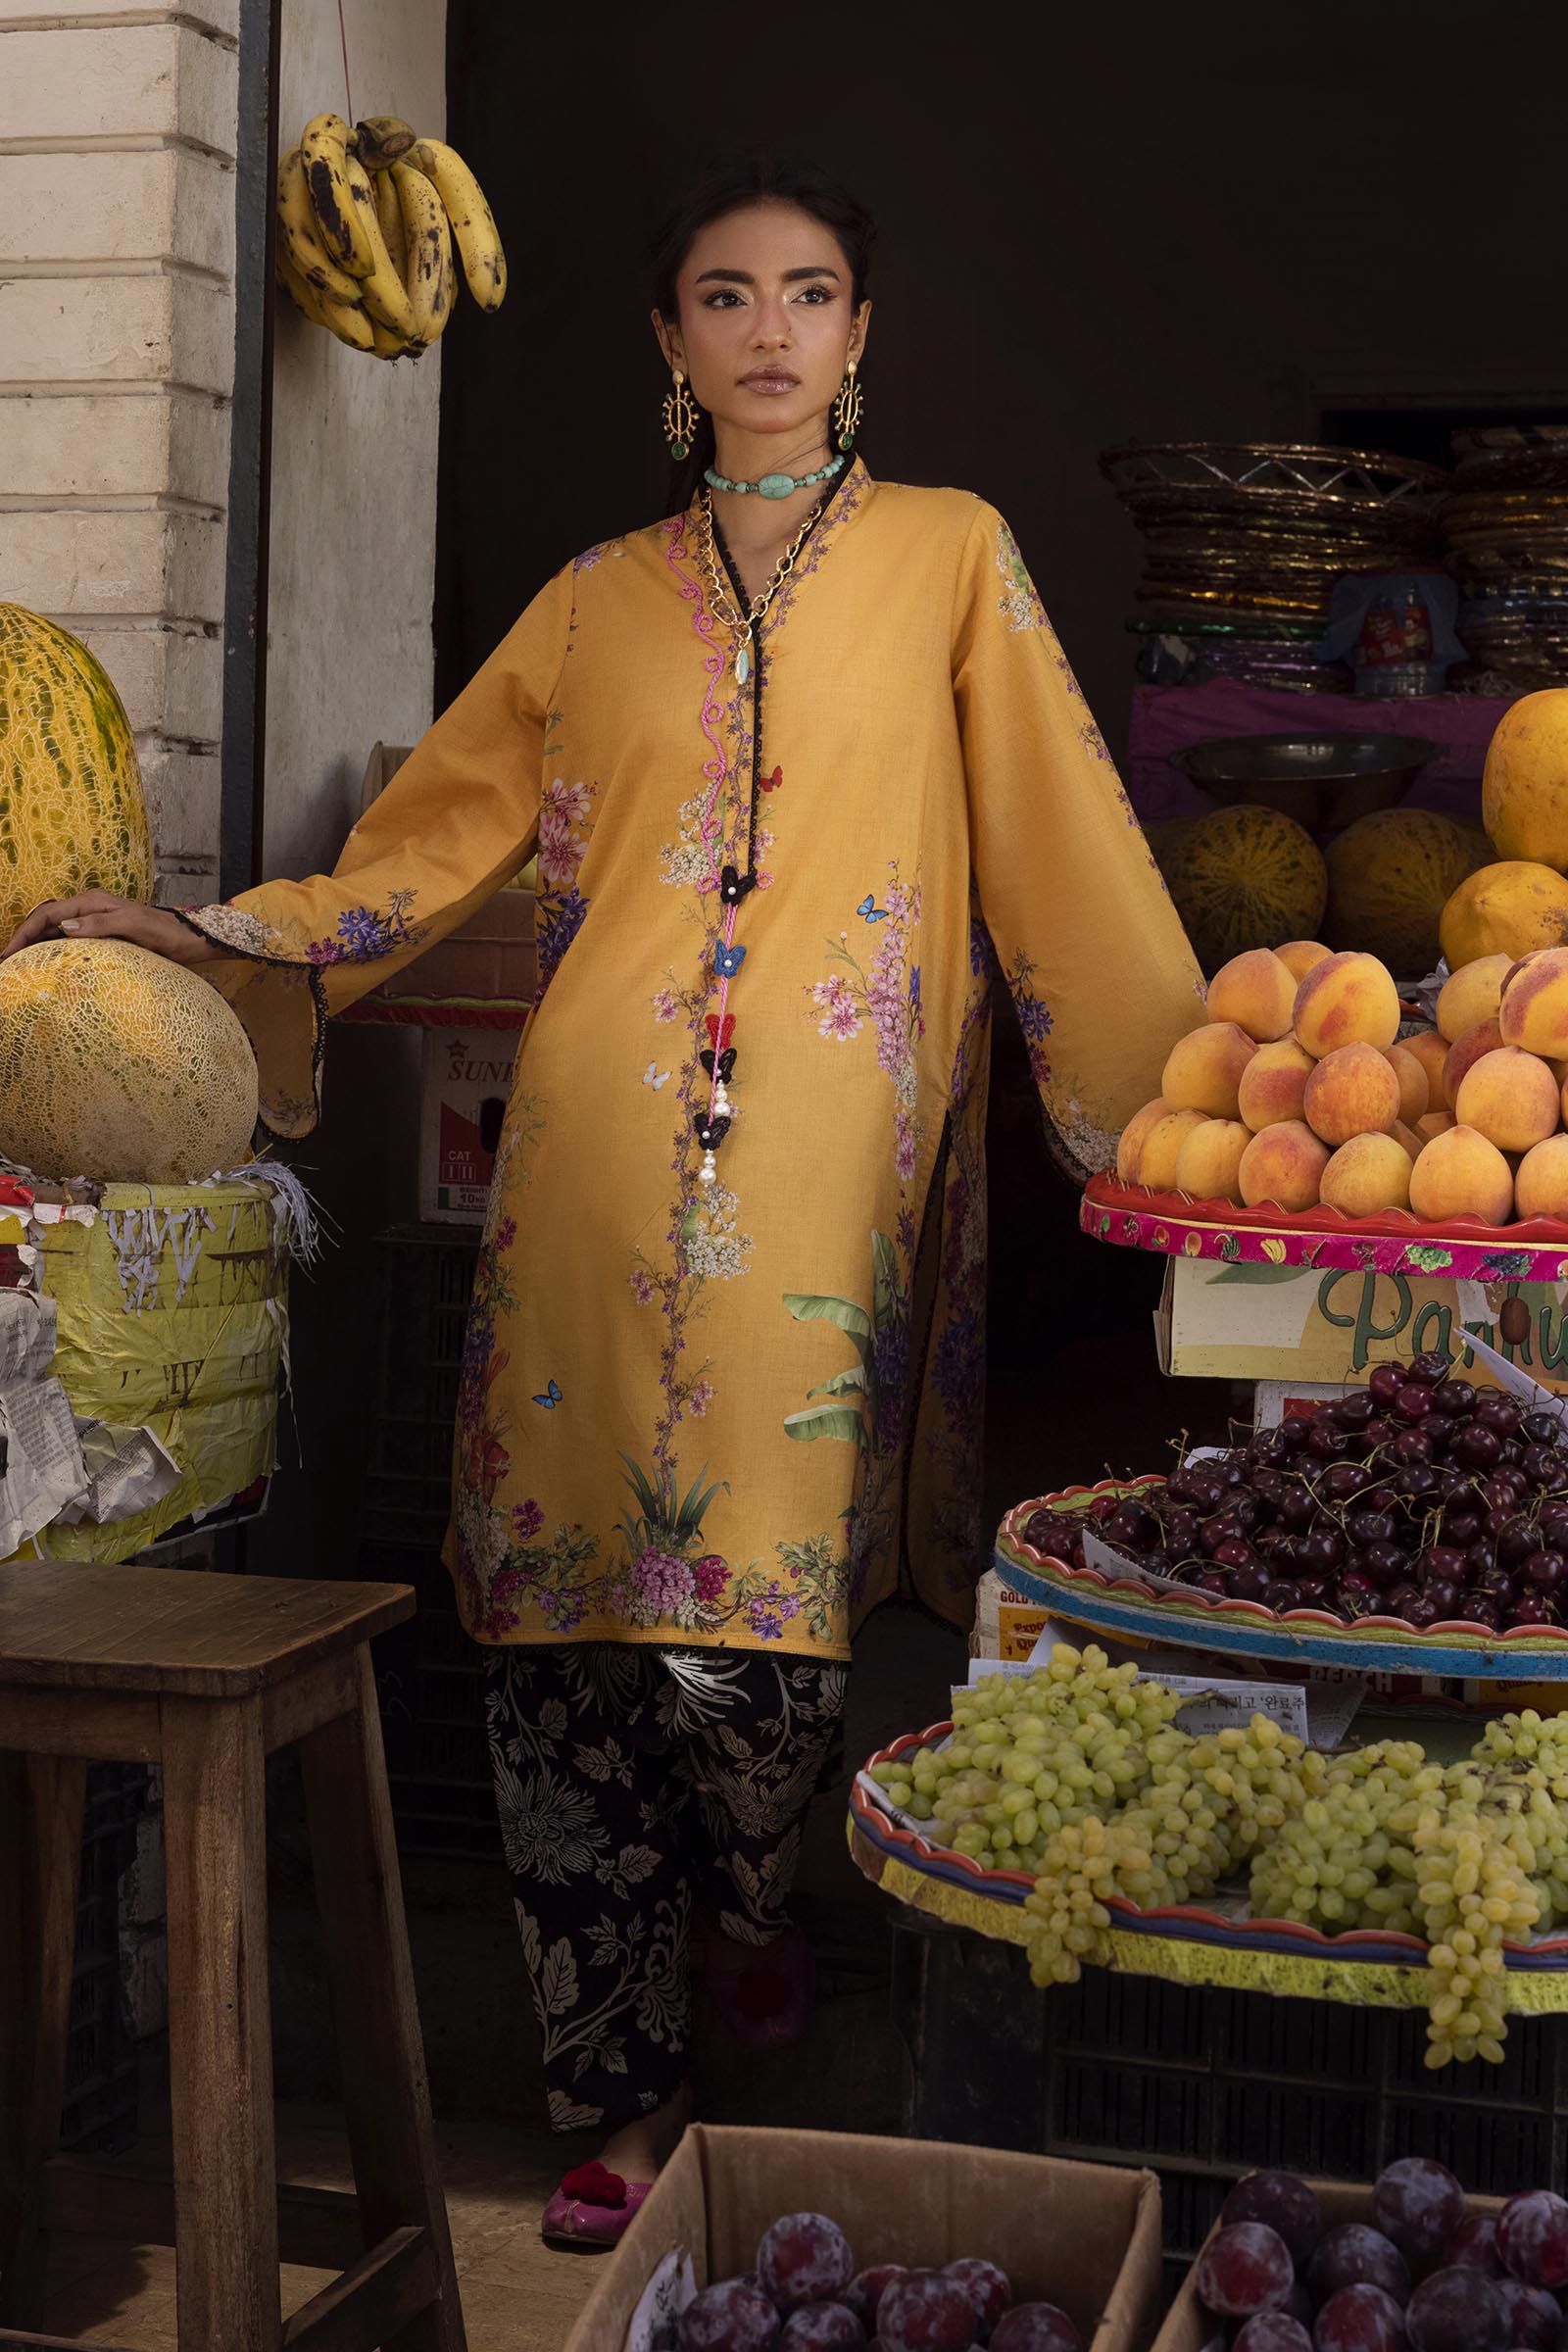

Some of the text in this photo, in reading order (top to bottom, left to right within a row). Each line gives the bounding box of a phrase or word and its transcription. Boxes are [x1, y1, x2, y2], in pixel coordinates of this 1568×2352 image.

[448, 1150, 471, 1161] CAT
[1000, 1591, 1029, 1604] GOLD
[1013, 1621, 1047, 1634] Expo
[1016, 1638, 1038, 1650] Qu
